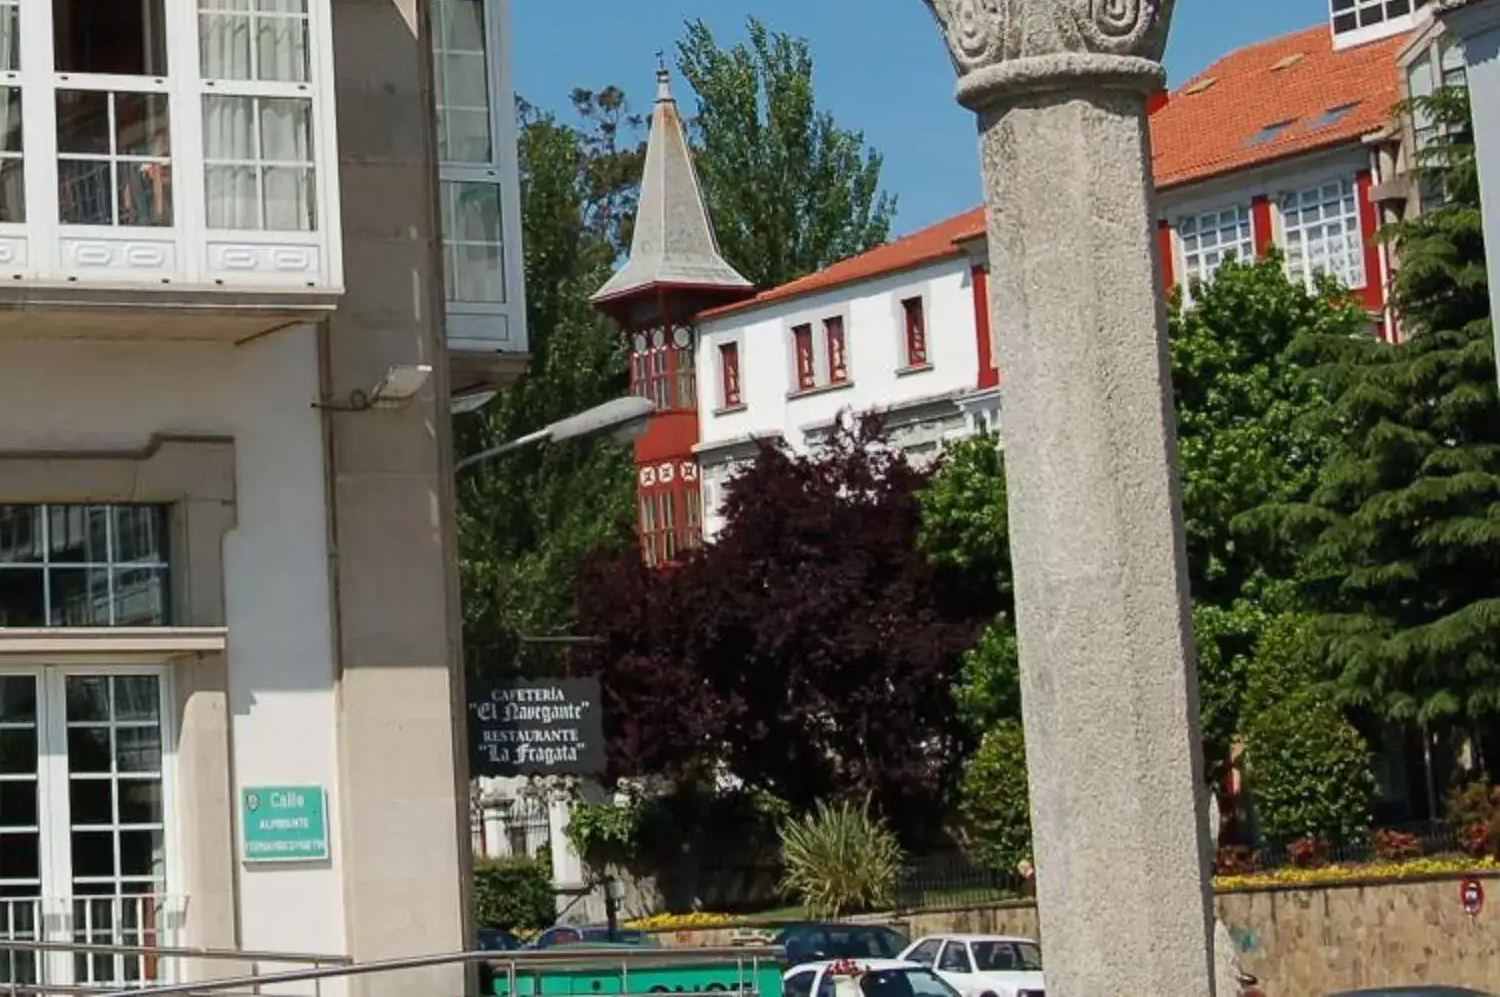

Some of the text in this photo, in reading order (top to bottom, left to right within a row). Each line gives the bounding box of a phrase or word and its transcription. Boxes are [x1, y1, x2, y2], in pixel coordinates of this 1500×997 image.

[491, 687, 564, 702] CAFETERÍA
[483, 729, 579, 742] RESTAURANTE
[270, 791, 305, 808] Calle
